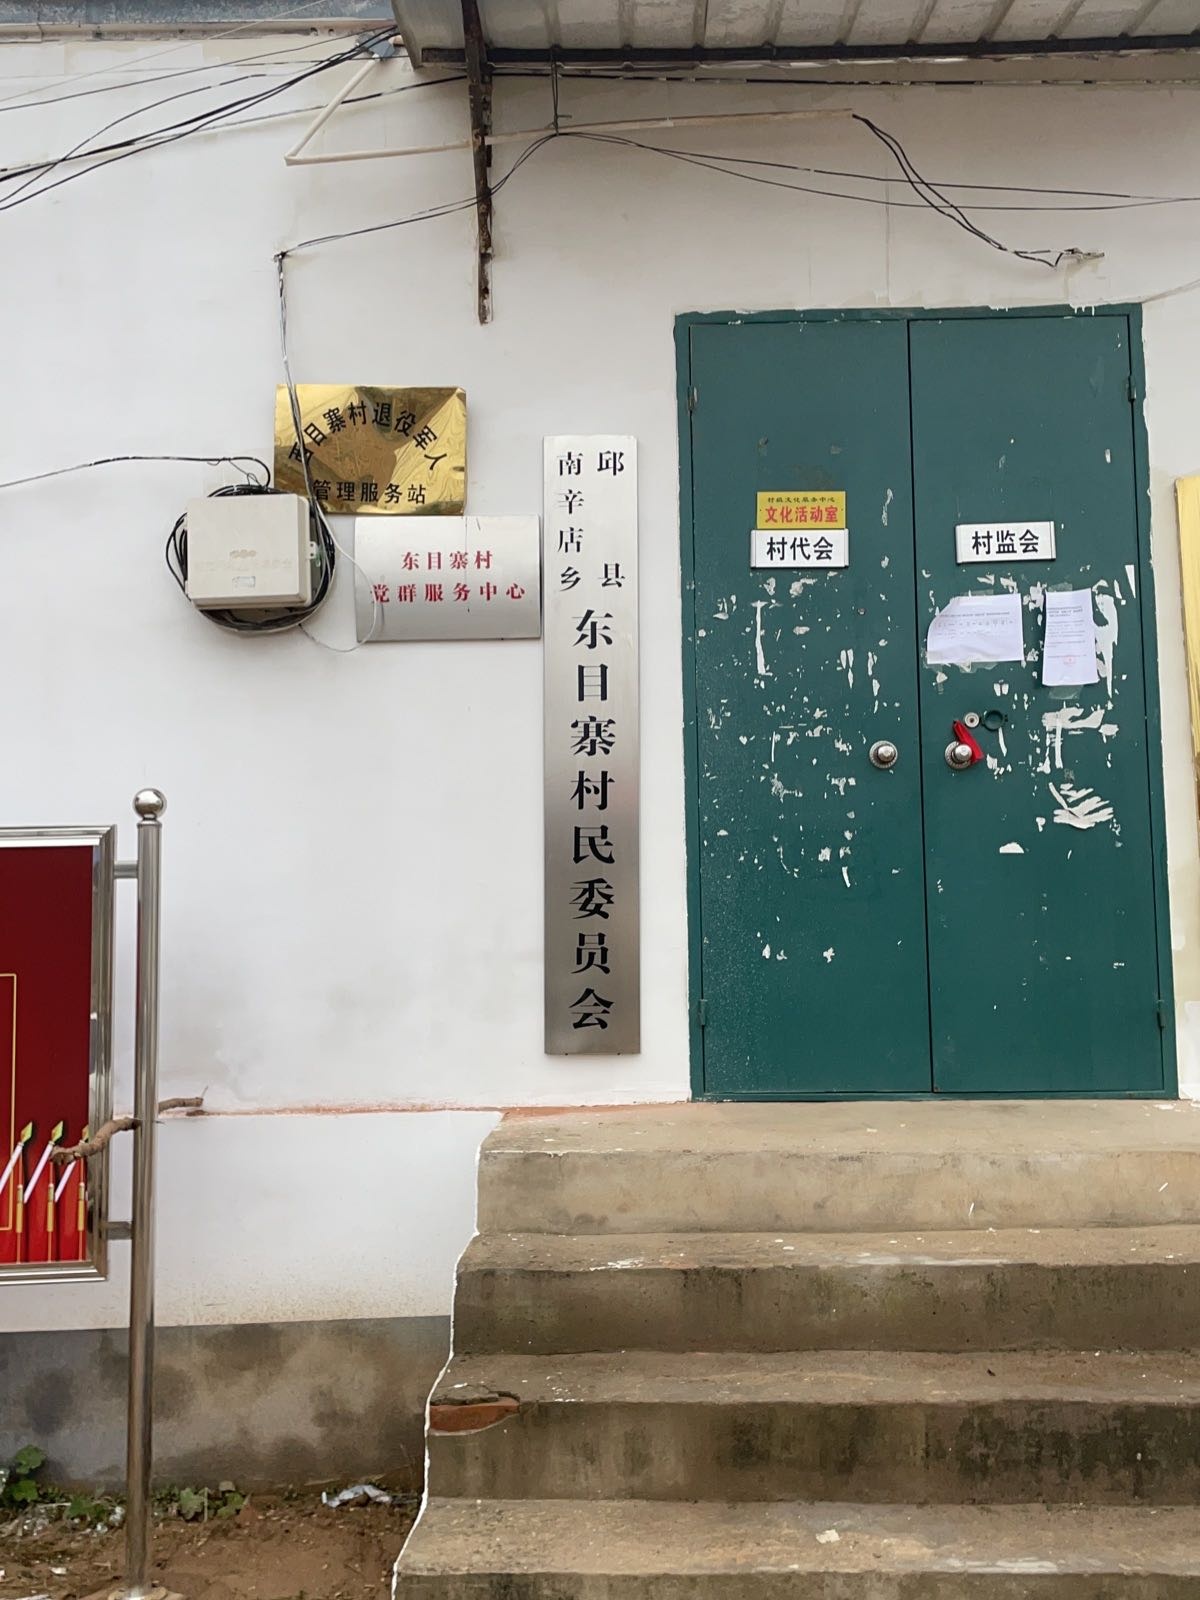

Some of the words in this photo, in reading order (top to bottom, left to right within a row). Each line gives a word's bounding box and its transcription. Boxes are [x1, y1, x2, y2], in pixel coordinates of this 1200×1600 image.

[312, 480, 427, 504] 管理服务站
[556, 451, 584, 592] 南辛店乡
[596, 450, 626, 588] 邱县
[764, 505, 839, 523] 文化活动室
[766, 536, 834, 561] 村代会
[971, 529, 1040, 555] 村监会
[401, 550, 494, 571] 东目寨村
[370, 582, 526, 603] 党群服务中心
[569, 608, 617, 1031] 东目寨村民委员会
